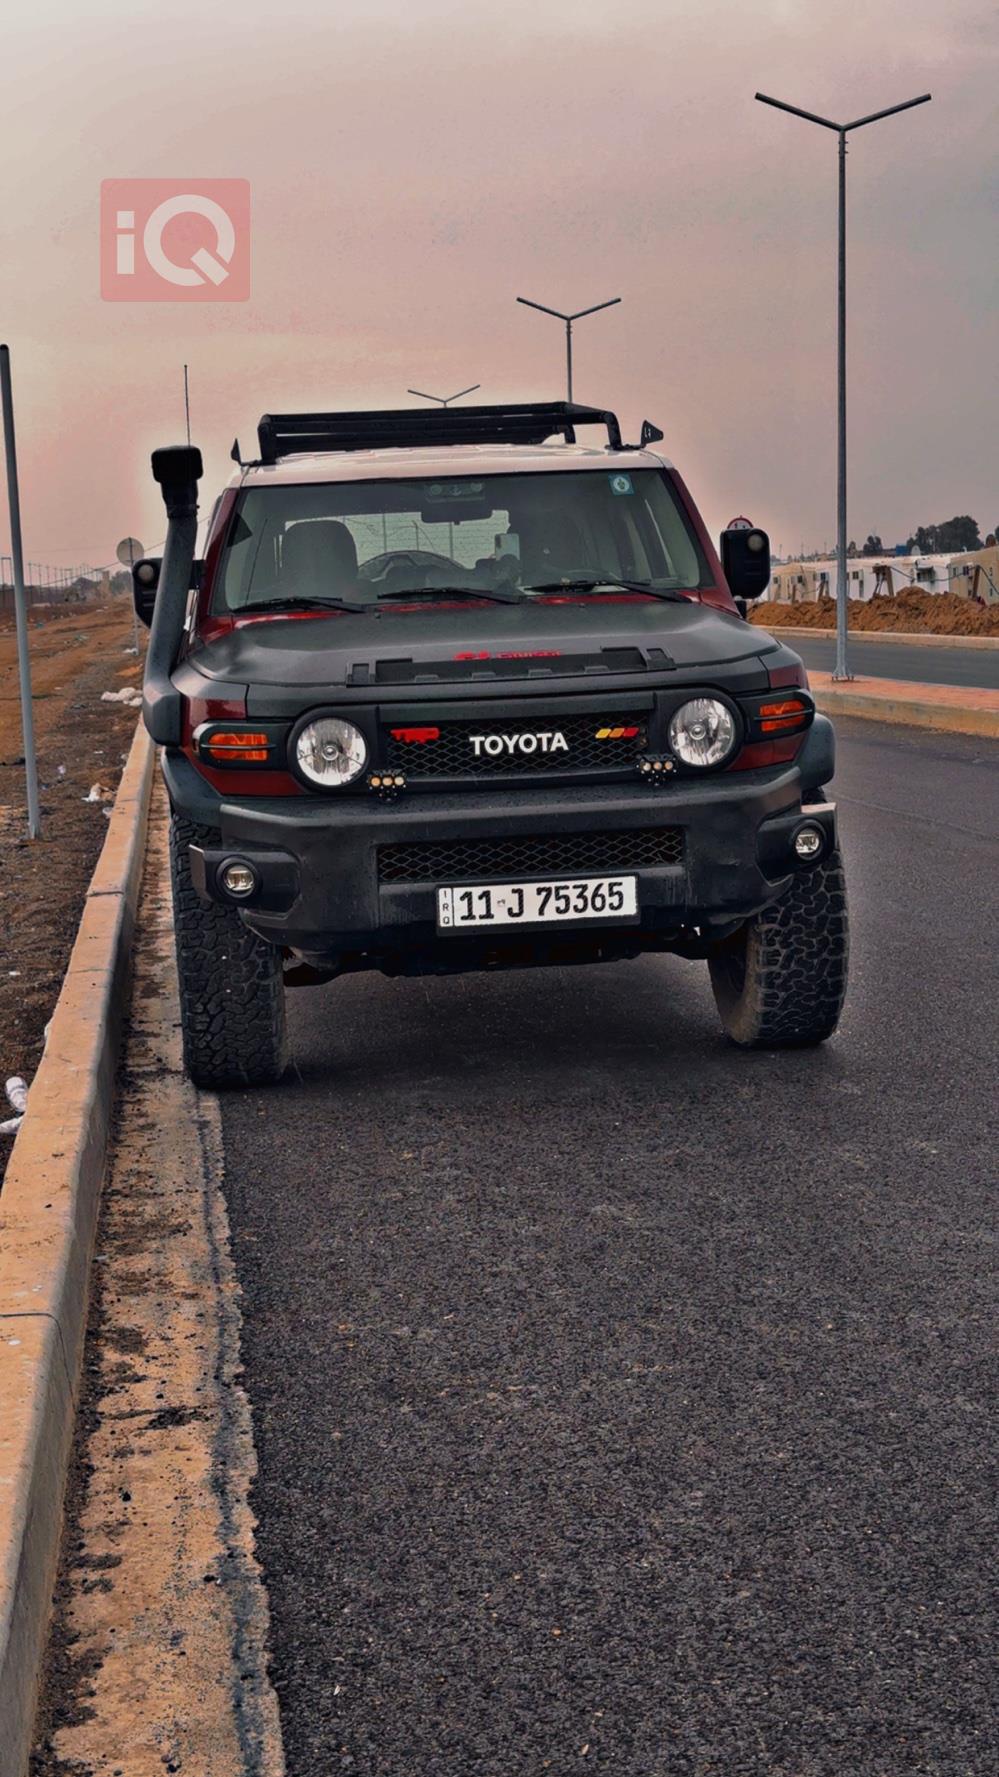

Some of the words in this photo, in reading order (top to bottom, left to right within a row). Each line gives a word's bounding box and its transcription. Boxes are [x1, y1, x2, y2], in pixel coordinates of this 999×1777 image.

[469, 732, 568, 755] TOYOTA
[442, 890, 450, 924] IRQ
[460, 890, 494, 920] 11
[507, 888, 524, 917] J
[536, 882, 624, 916] 75365
